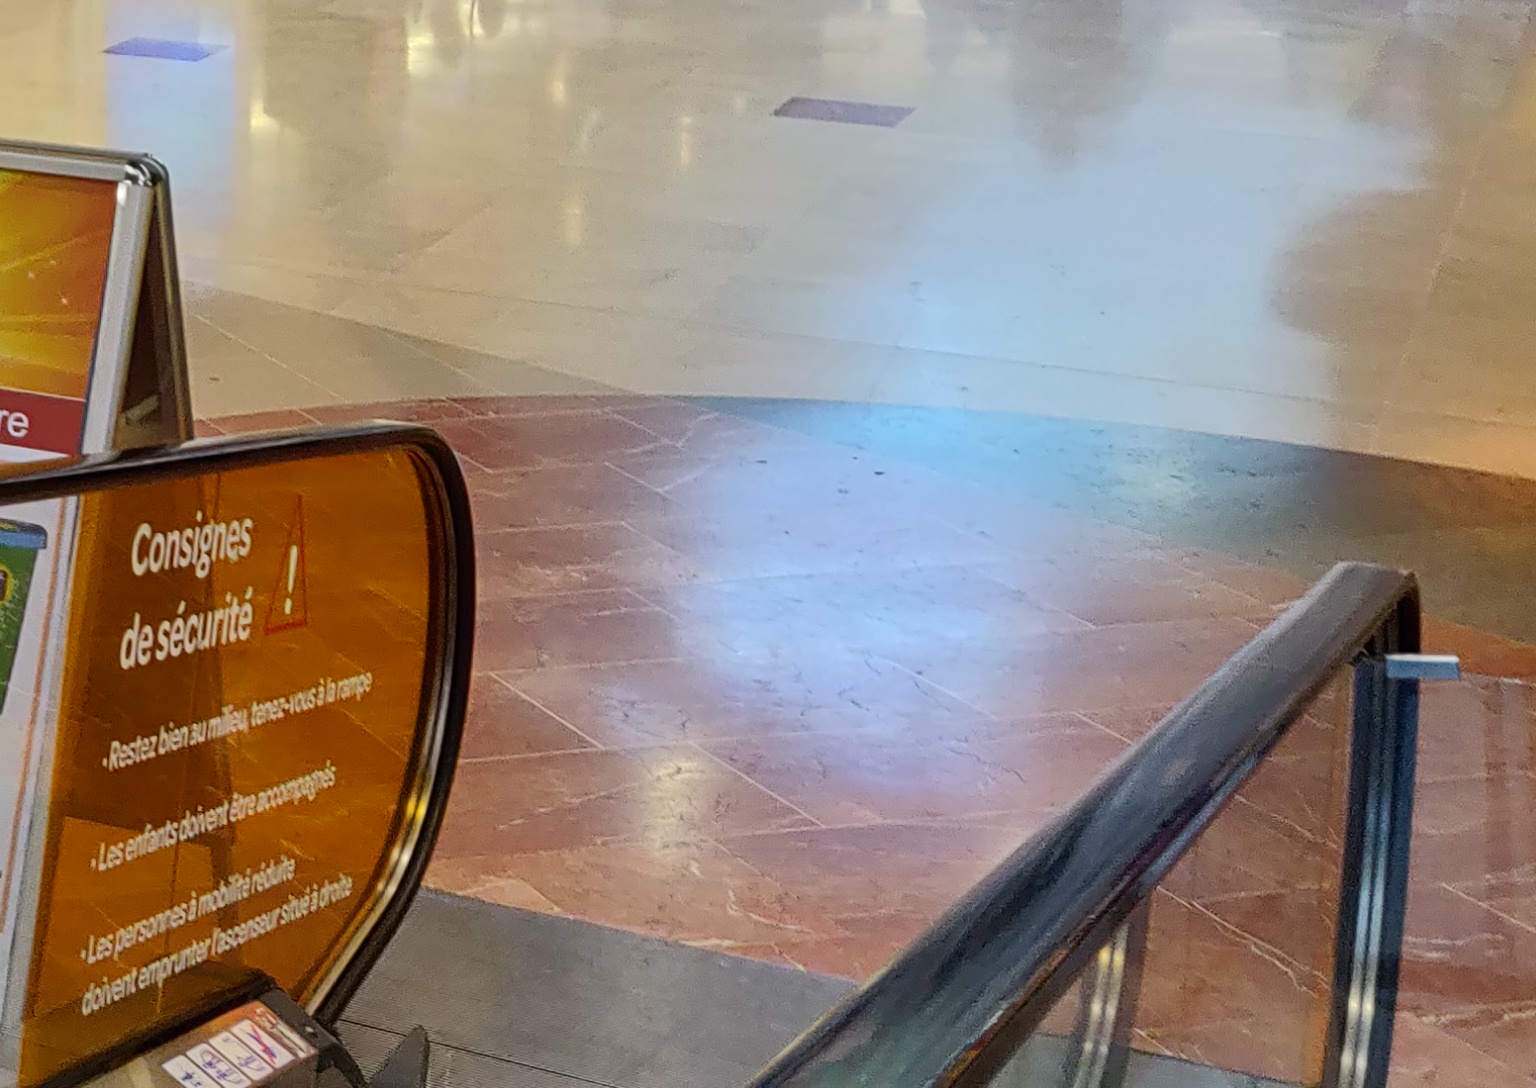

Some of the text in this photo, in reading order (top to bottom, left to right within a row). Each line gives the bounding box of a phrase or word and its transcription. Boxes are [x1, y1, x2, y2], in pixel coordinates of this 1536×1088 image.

[131, 510, 254, 580] Consignes
[119, 585, 254, 670] de sécurité
[109, 735, 157, 772] Restez
[158, 722, 189, 755] bien
[189, 720, 206, 746] au
[251, 686, 317, 727] tenez-vous
[316, 677, 325, 706] à
[326, 676, 335, 703] la
[336, 671, 373, 701] rampe
[97, 759, 337, 872] Les enfants doivent être accompagnés
[81, 871, 354, 1016] doivent emprunter l'ascenseur situé à droite
[87, 854, 296, 964] Les personnes à mobilité réduite
